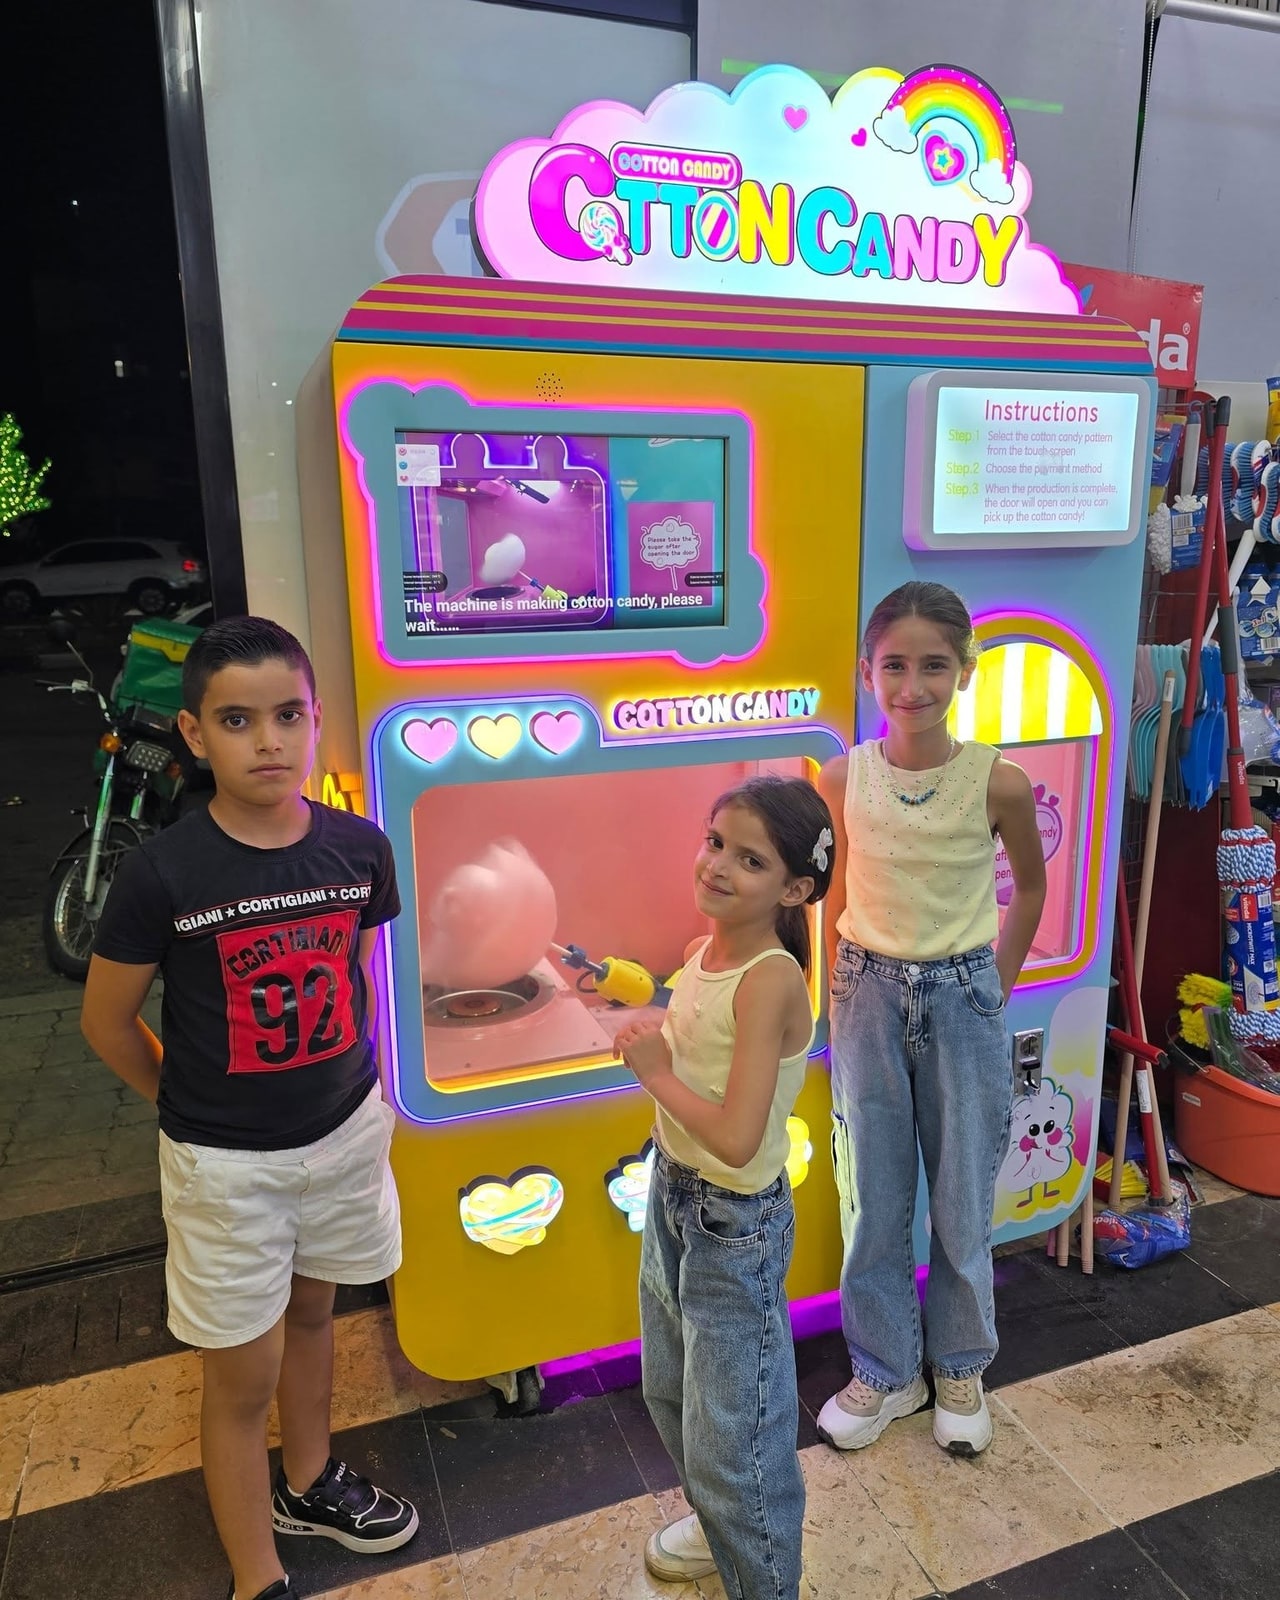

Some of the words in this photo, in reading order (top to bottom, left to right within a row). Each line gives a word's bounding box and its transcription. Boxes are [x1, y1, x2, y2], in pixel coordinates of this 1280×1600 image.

[618, 152, 680, 176] COTTON
[682, 159, 731, 181] CANDY
[797, 186, 1023, 287] CANDY
[985, 400, 1099, 422] Instructions
[987, 430, 1013, 442] Select
[1015, 430, 1029, 442] the
[1031, 431, 1057, 442] cotton
[1058, 432, 1083, 444] candy
[1084, 432, 1113, 444] pattern
[987, 444, 1007, 456] from
[1009, 444, 1023, 456] the
[946, 462, 980, 477] Step.2
[985, 462, 1017, 474] Choose
[1019, 462, 1033, 474] the
[1072, 463, 1102, 474] method
[945, 482, 979, 498] Step.3
[985, 483, 1010, 494] When
[1011, 483, 1026, 494] the
[1027, 483, 1071, 496] production
[1072, 482, 1079, 493] is
[984, 497, 999, 508] the
[1000, 498, 1019, 508] door
[1021, 497, 1036, 508] will
[1037, 499, 1058, 510] open
[1060, 497, 1076, 508] and
[1076, 499, 1092, 509] you
[1093, 499, 1109, 507] can
[983, 511, 1001, 524] pick
[1002, 514, 1014, 524] up
[1015, 511, 1030, 522] the
[1031, 512, 1057, 522] cotton
[1058, 510, 1086, 523] candy!
[404, 599, 432, 613] The
[436, 598, 498, 612] machine
[501, 598, 514, 611] is
[517, 596, 568, 612] making
[571, 596, 614, 609] cotton
[617, 593, 658, 609] candy,
[661, 593, 703, 609] please
[613, 693, 732, 730] COTTON
[732, 687, 820, 722] CANDY
[238, 889, 327, 914] CORTIGIANI
[227, 926, 346, 979] CORTIGIAN
[251, 964, 344, 1065] 92
